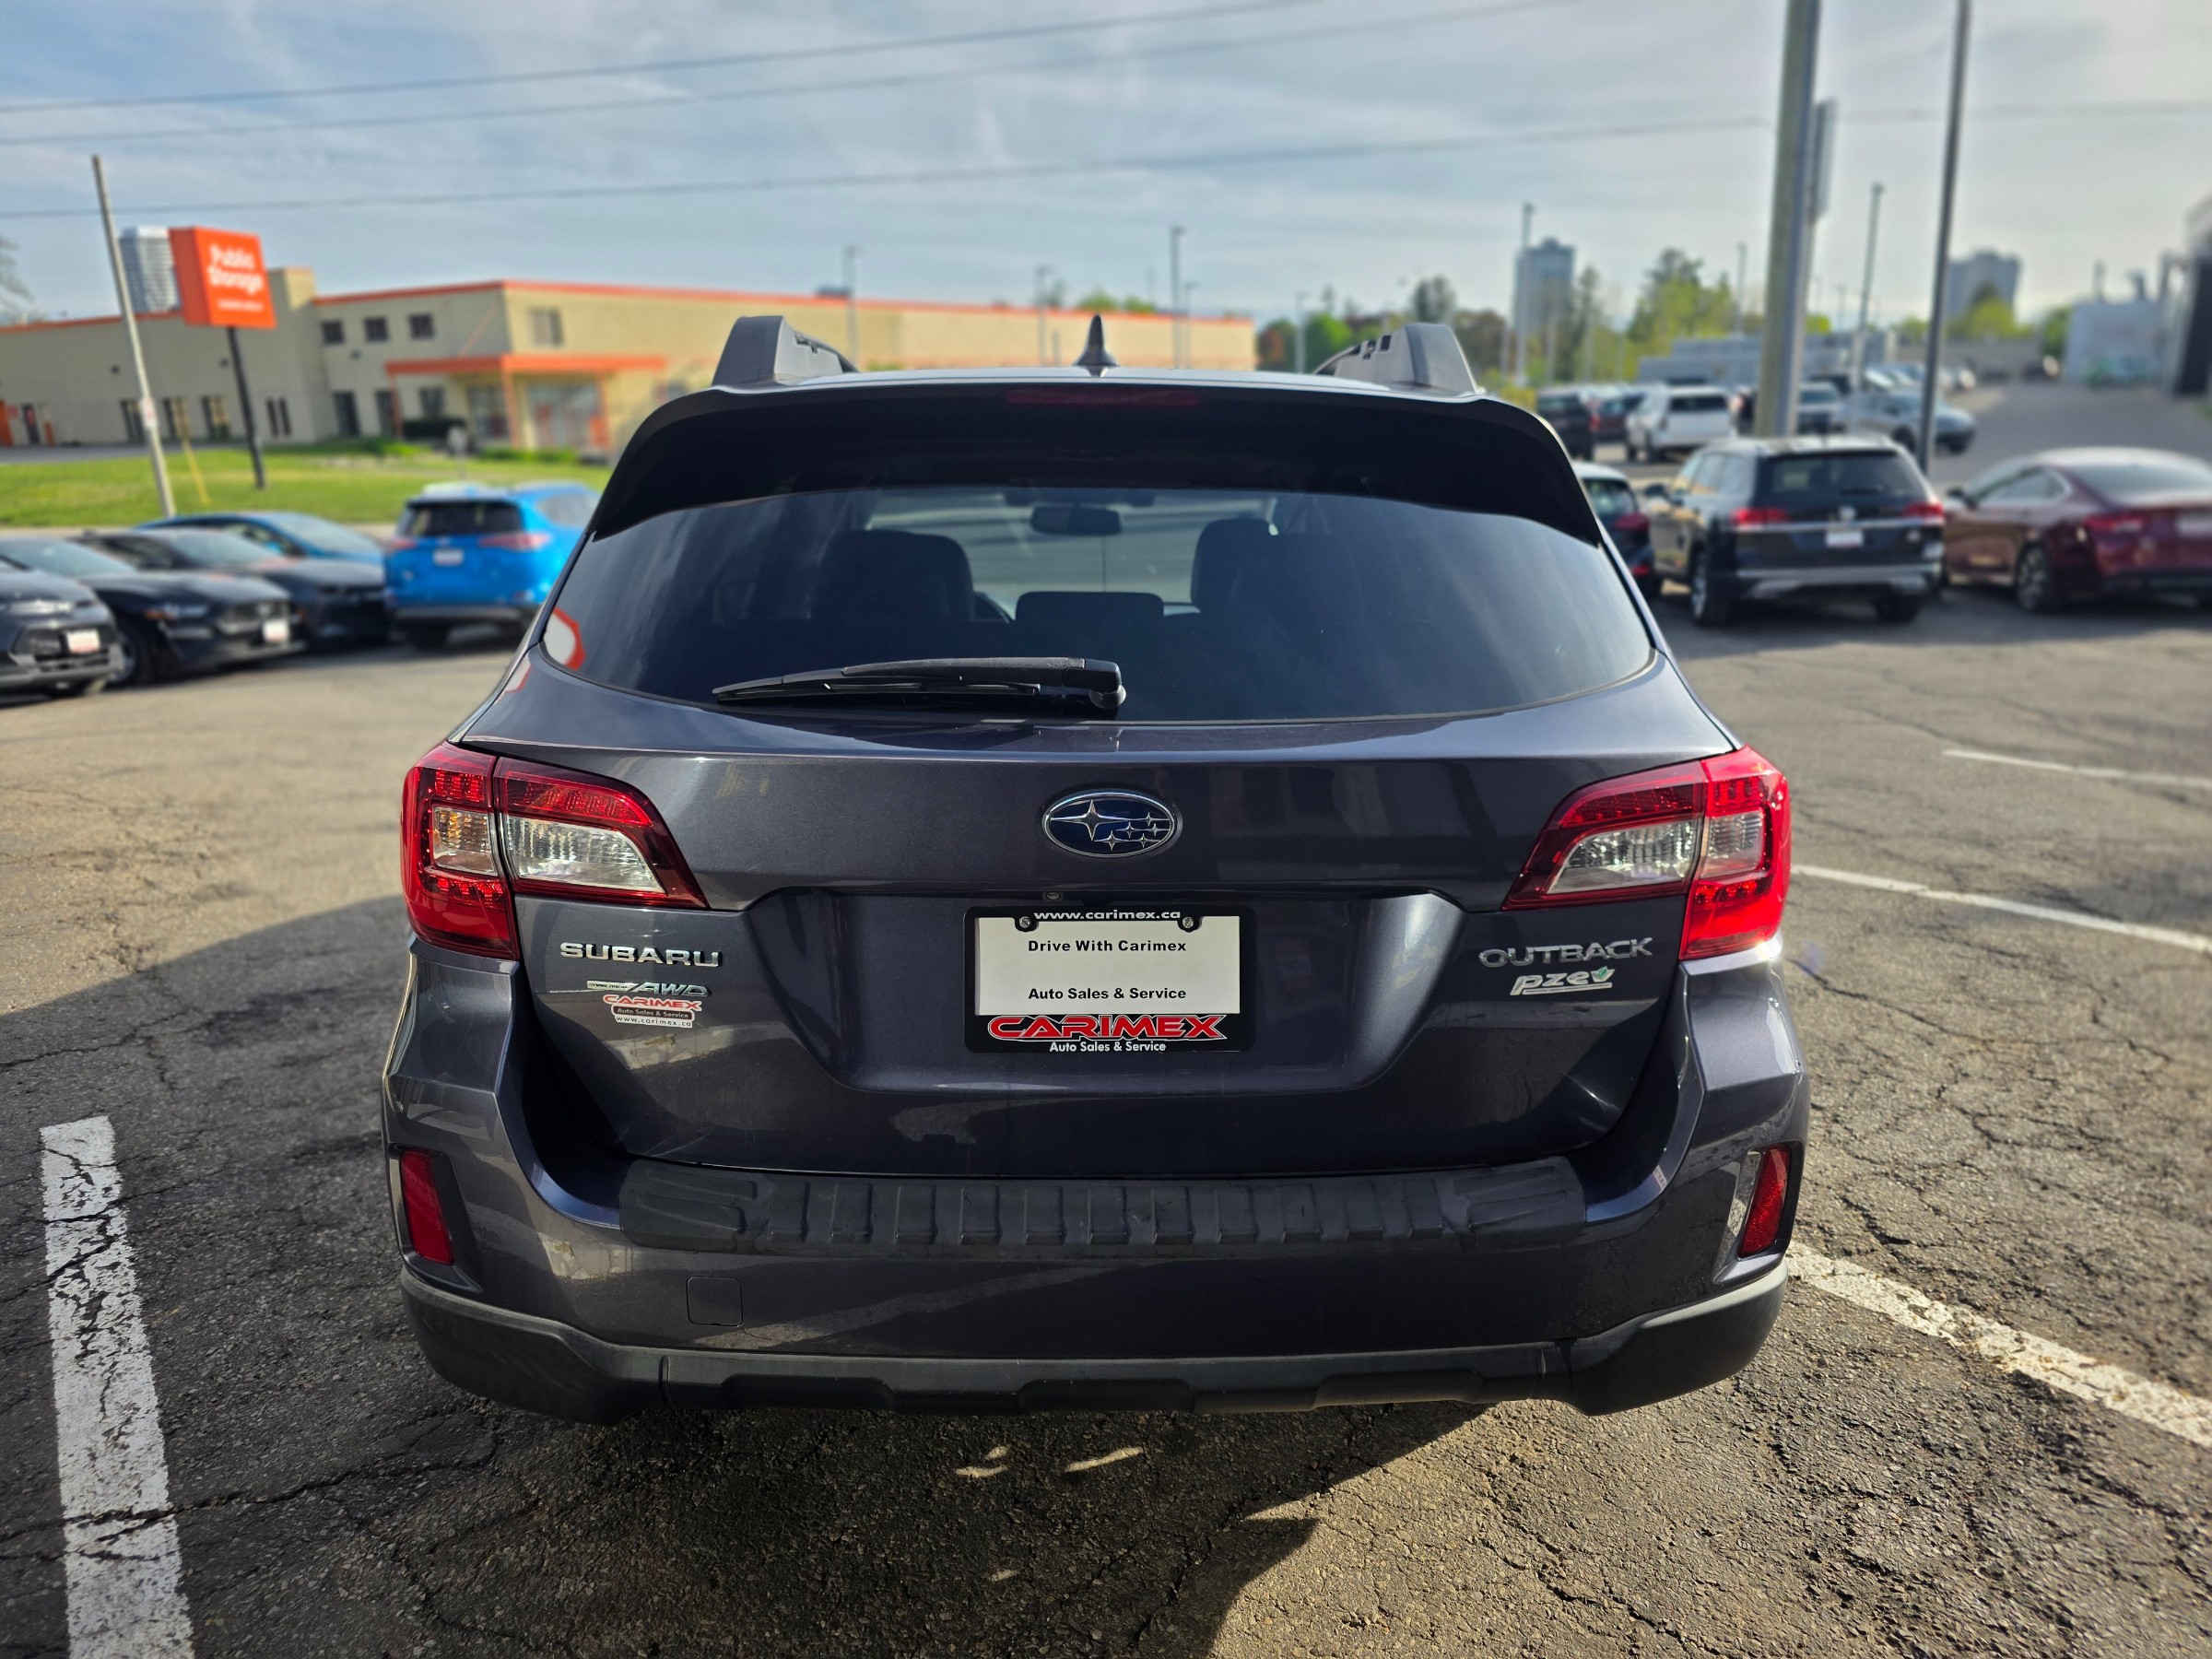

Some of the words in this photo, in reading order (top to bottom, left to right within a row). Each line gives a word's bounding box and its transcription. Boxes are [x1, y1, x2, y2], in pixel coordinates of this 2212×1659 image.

[1033, 910, 1181, 920] www.carimex.ca
[1028, 940, 1071, 951] Drive
[1076, 940, 1113, 951] With
[1118, 940, 1187, 951] Carimex
[559, 942, 721, 968] SUBARU
[1478, 937, 1653, 968] OUTBACK
[631, 982, 711, 996] AWD
[1029, 988, 1064, 999] Auto
[1067, 987, 1109, 999] Sales
[1113, 987, 1125, 999] &
[1129, 987, 1186, 999] Service
[604, 995, 701, 1010] CARIMEX
[635, 1008, 654, 1017] Sales
[616, 1016, 691, 1027] www.carimex.ca
[989, 1015, 1227, 1041] CARIMEX
[1049, 1041, 1077, 1052] Auto
[1080, 1041, 1110, 1052] Sales
[1113, 1041, 1123, 1052] &
[1125, 1041, 1166, 1052] Service
